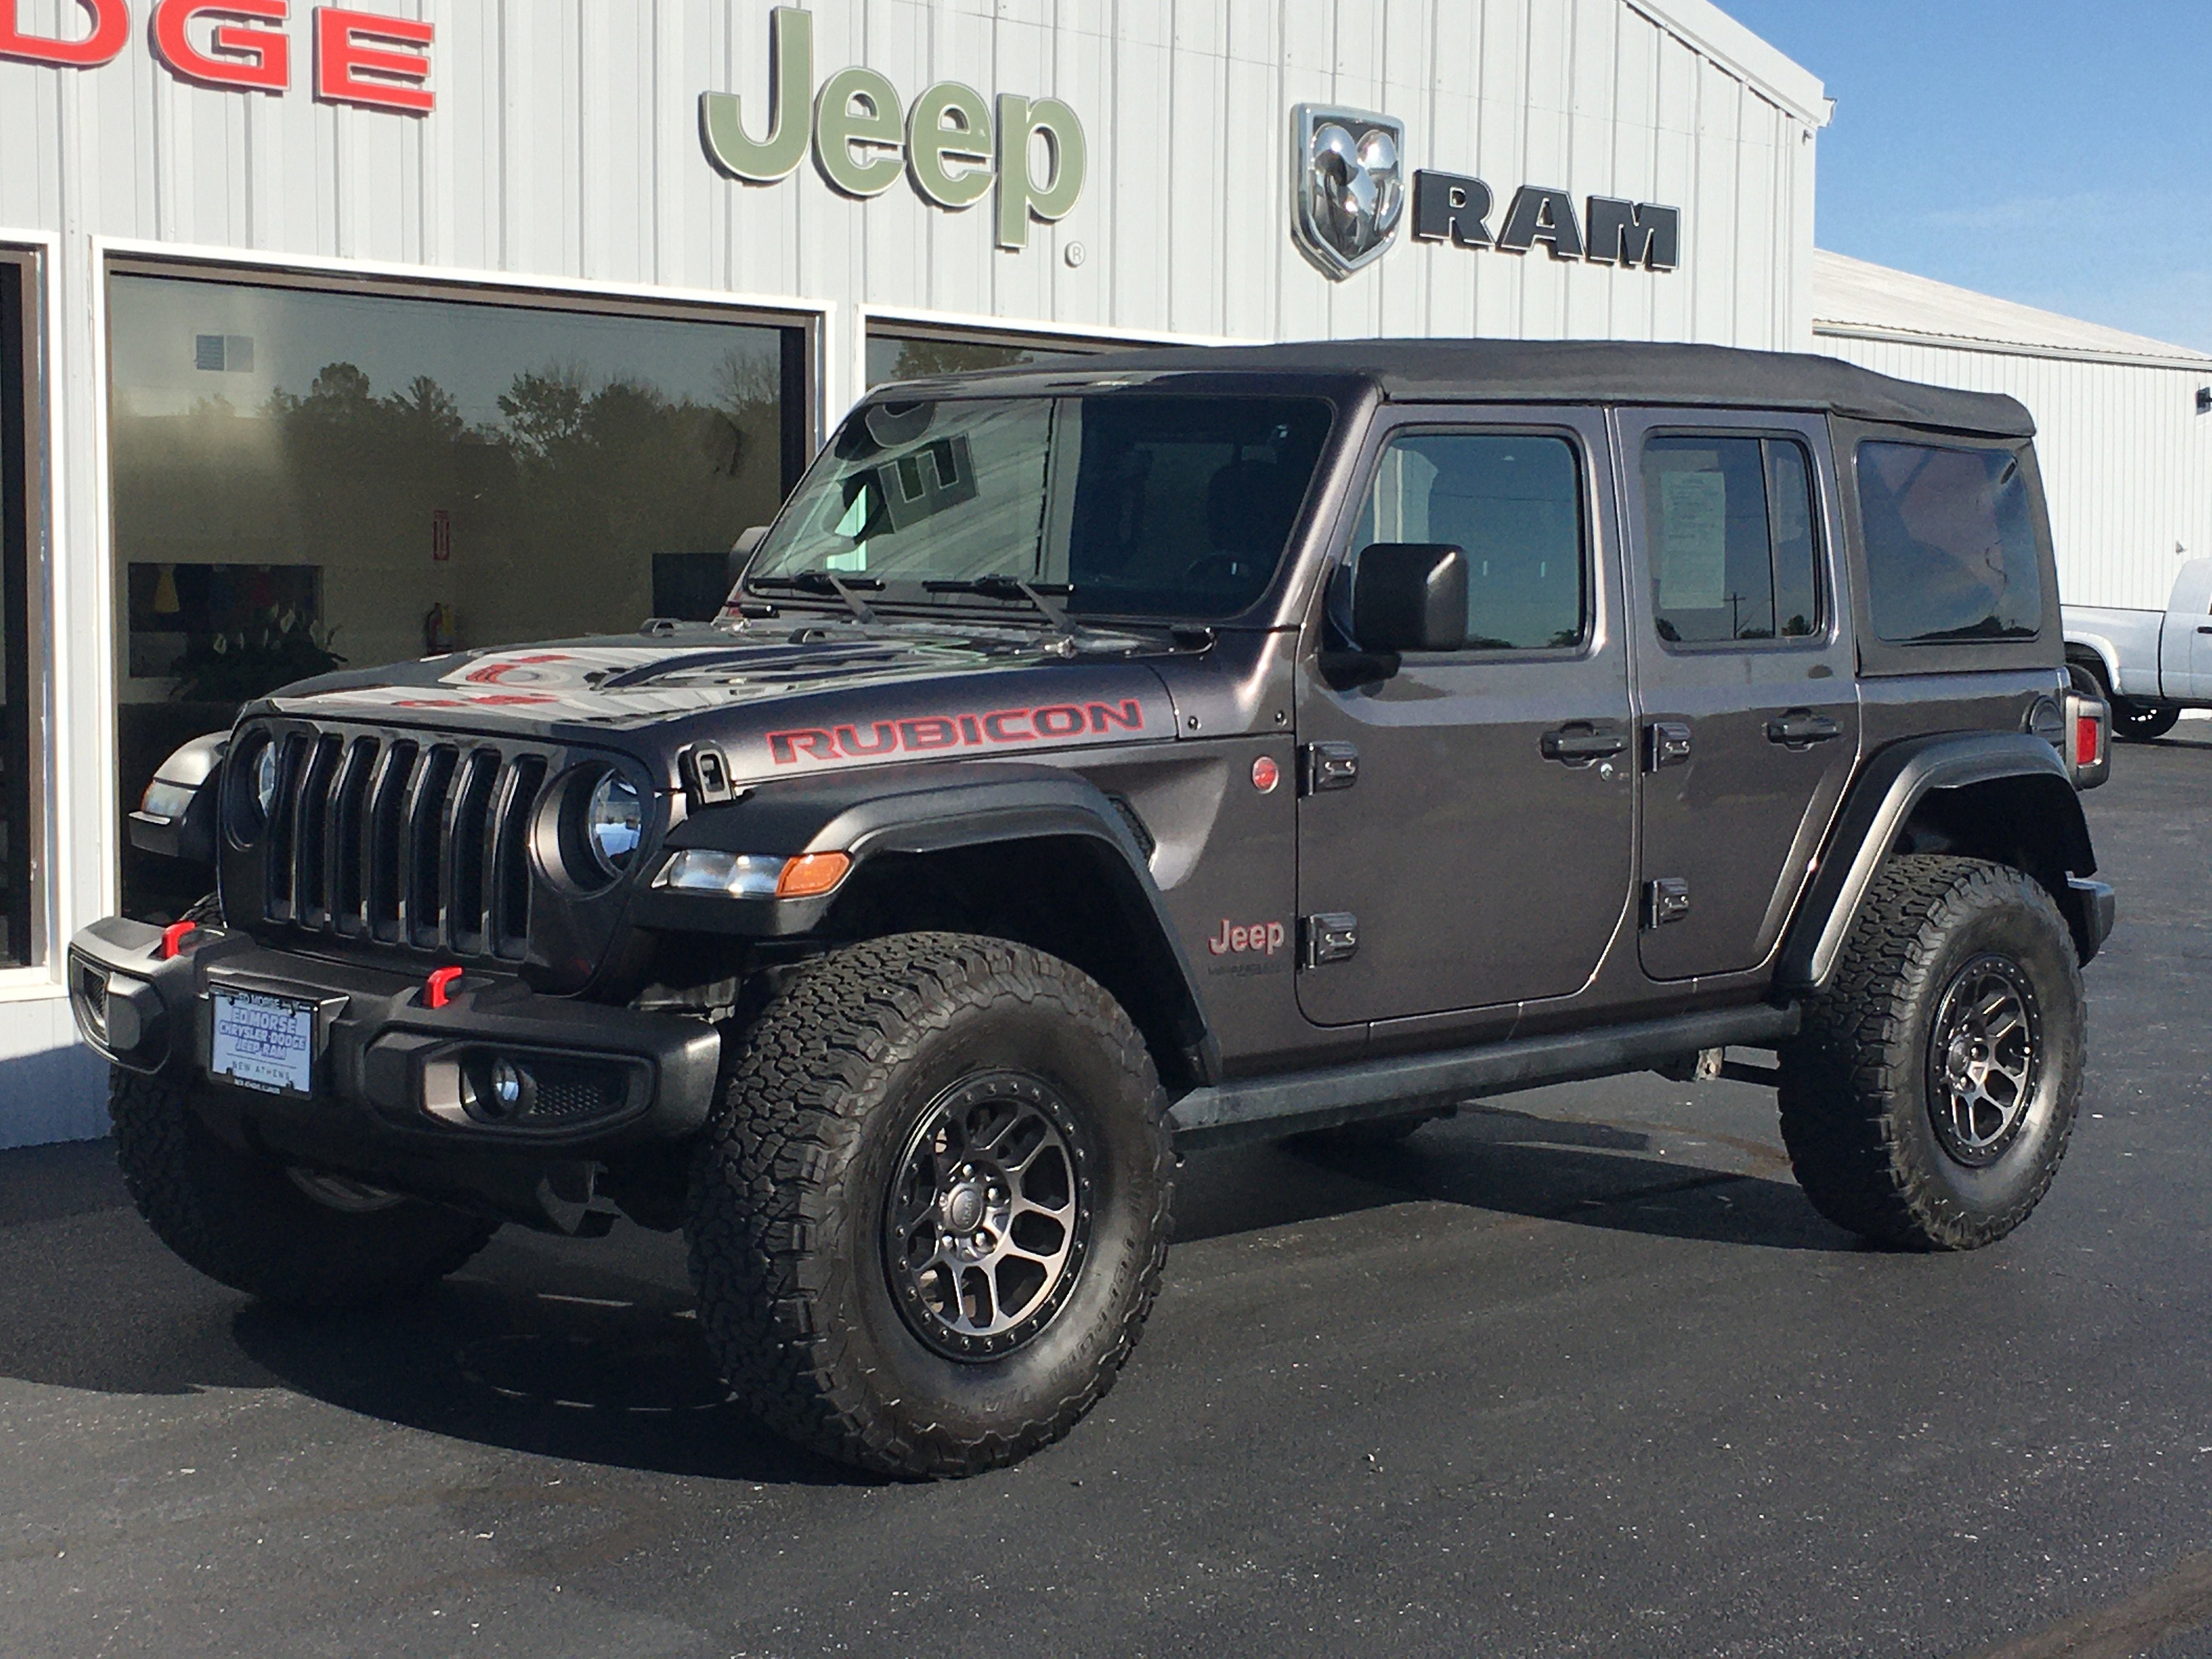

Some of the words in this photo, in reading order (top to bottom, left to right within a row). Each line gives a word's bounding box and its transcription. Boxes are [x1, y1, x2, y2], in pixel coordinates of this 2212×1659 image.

[699, 5, 1087, 251] Jeep
[1412, 168, 1681, 271] RAM
[766, 698, 1144, 765] RUBICON
[1208, 918, 1284, 957] Jeep
[232, 1006, 247, 1024] ED
[250, 1010, 297, 1034] MORSE
[232, 1060, 250, 1071] NEW
[255, 1065, 290, 1081] ATHENS
